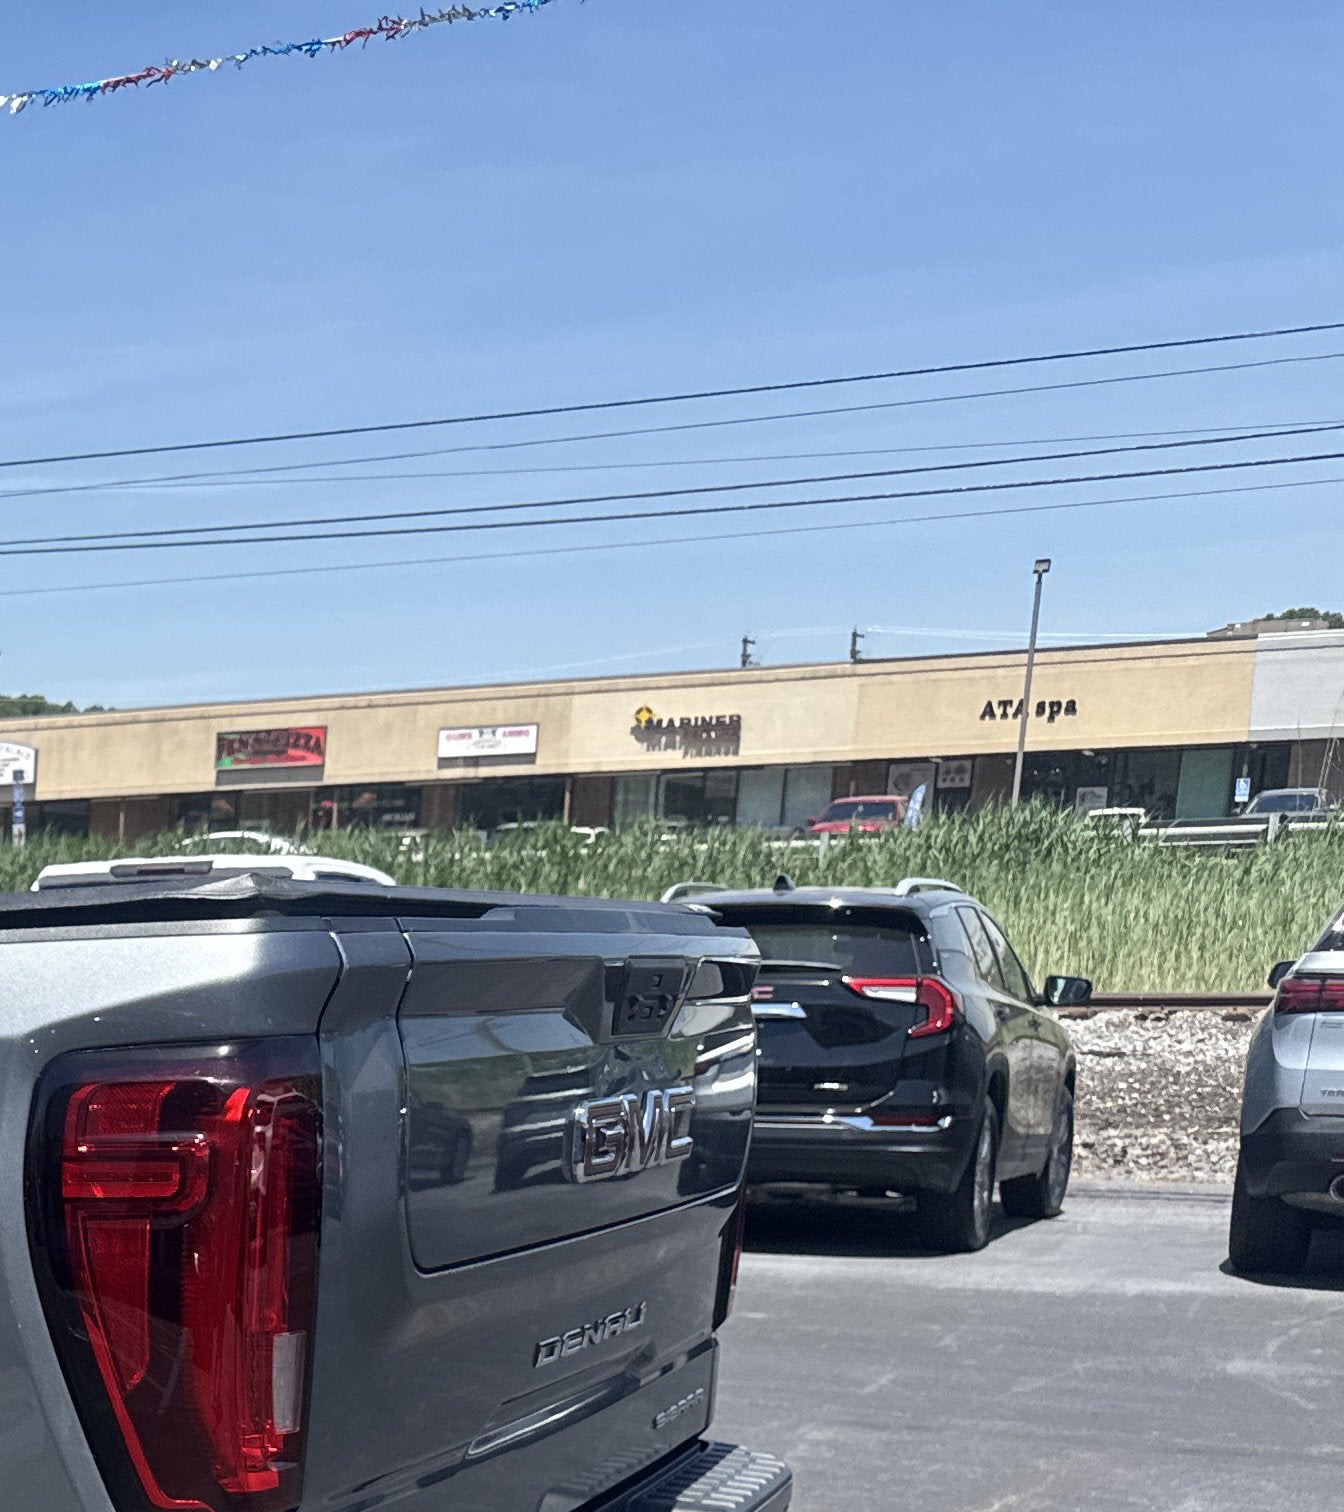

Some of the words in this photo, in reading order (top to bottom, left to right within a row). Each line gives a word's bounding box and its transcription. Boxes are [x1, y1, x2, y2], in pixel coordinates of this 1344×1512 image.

[1035, 699, 1076, 723] spa
[574, 1086, 695, 1182] GMC
[533, 1302, 647, 1368] DENALI
